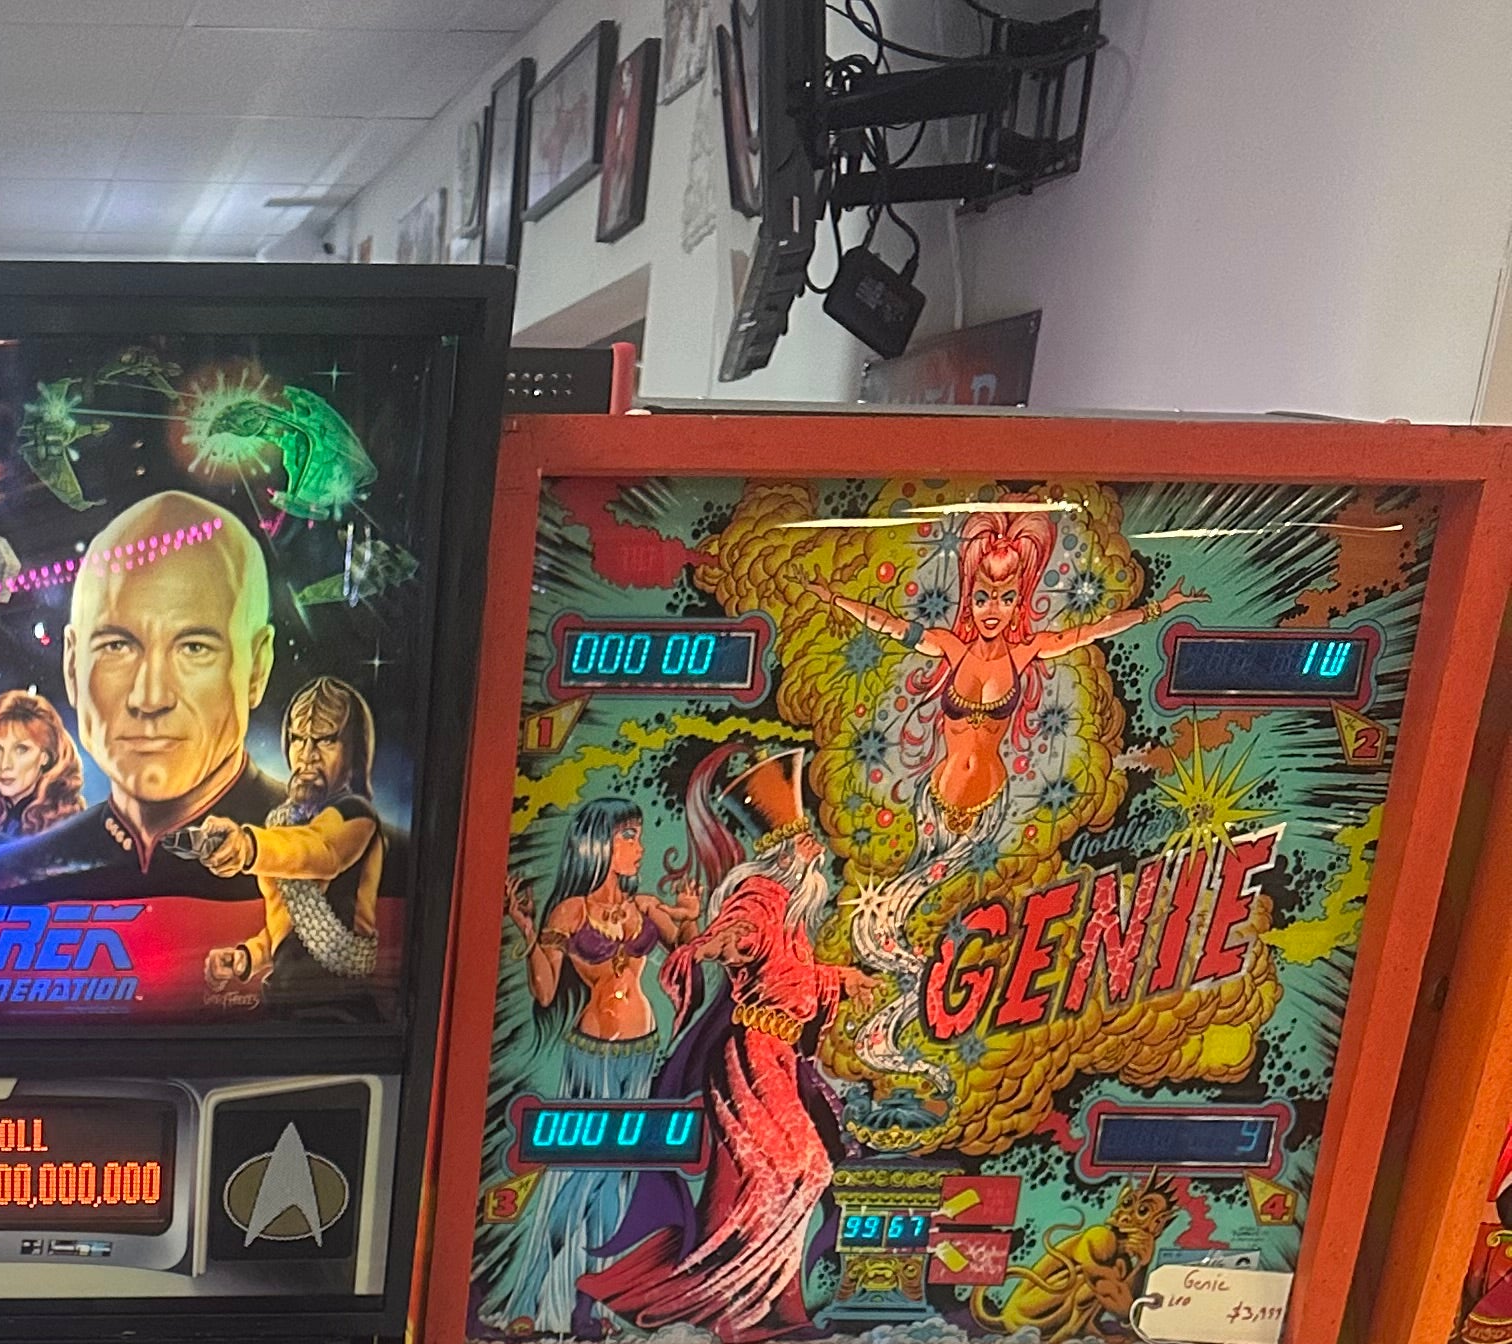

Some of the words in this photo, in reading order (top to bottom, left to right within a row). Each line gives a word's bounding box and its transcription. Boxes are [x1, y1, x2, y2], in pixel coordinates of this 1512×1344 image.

[1352, 727, 1381, 758] 2
[922, 822, 1287, 1043] GENIE
[492, 1188, 519, 1217] 3
[1259, 1193, 1289, 1220] 4
[1183, 1269, 1231, 1292] Genie
